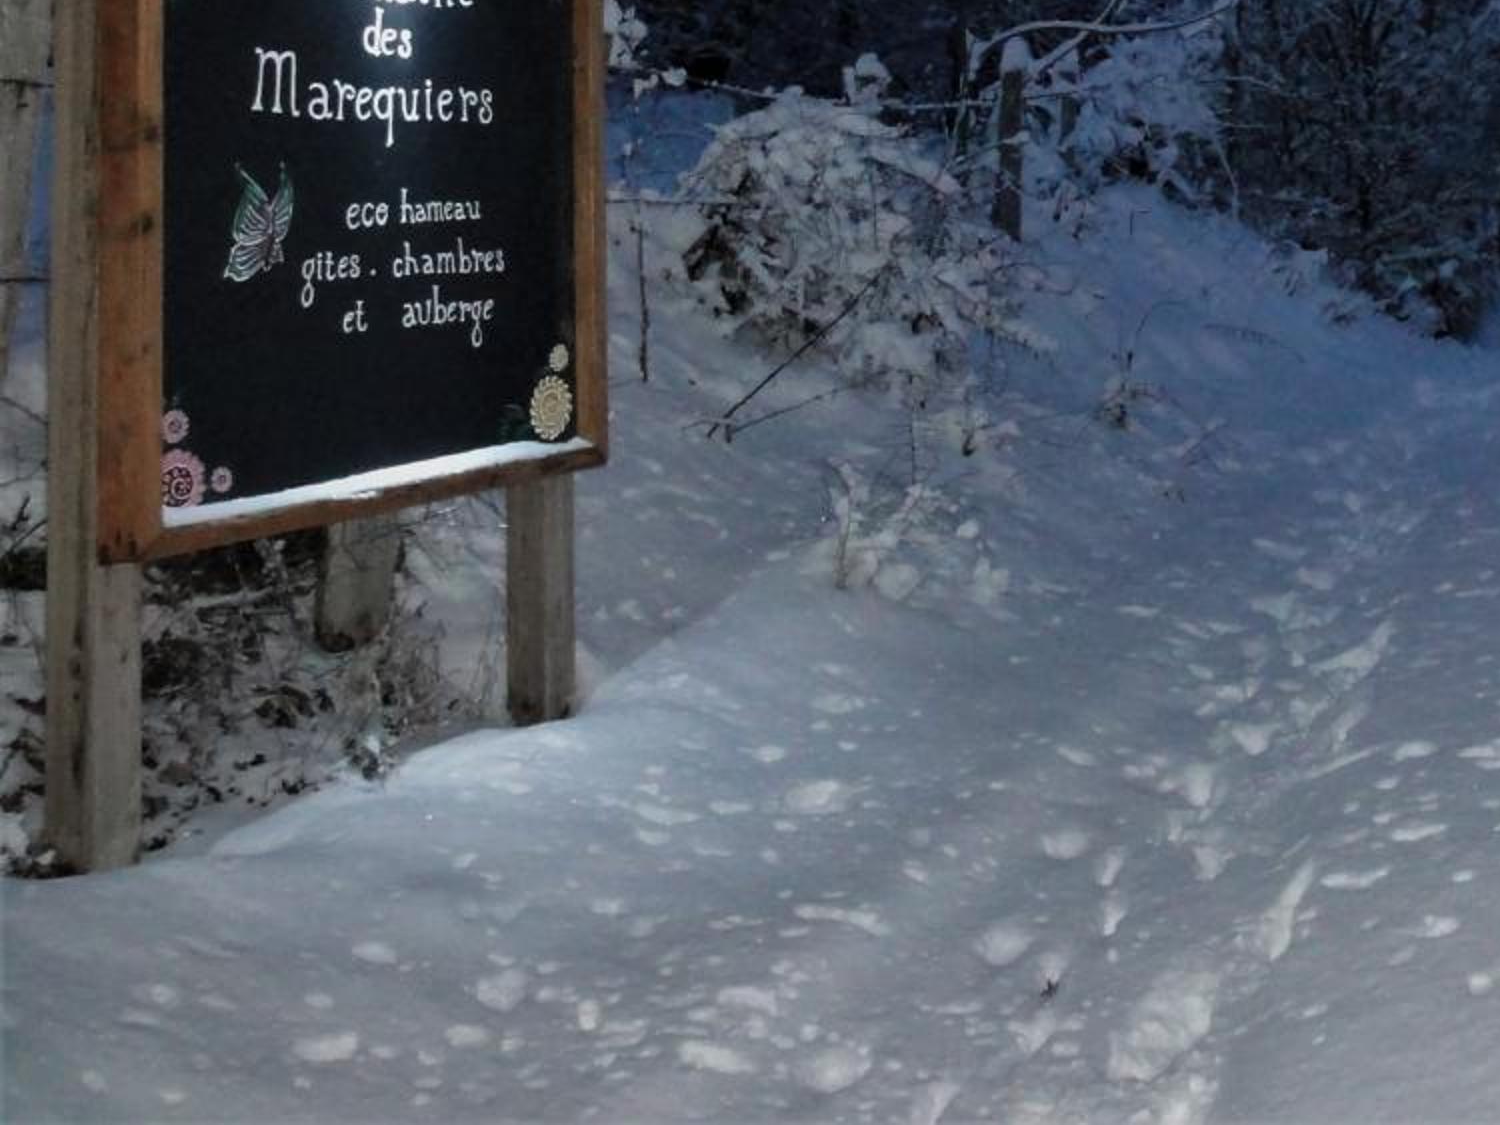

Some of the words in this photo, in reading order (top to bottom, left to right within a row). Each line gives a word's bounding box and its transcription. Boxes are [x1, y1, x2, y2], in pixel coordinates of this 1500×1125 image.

[362, 6, 413, 59] des
[251, 46, 493, 148] Marequiers
[345, 202, 389, 230] eco
[400, 187, 481, 224] hameau
[392, 236, 505, 278] chambres
[342, 299, 368, 334] et
[402, 284, 495, 348] auberge
